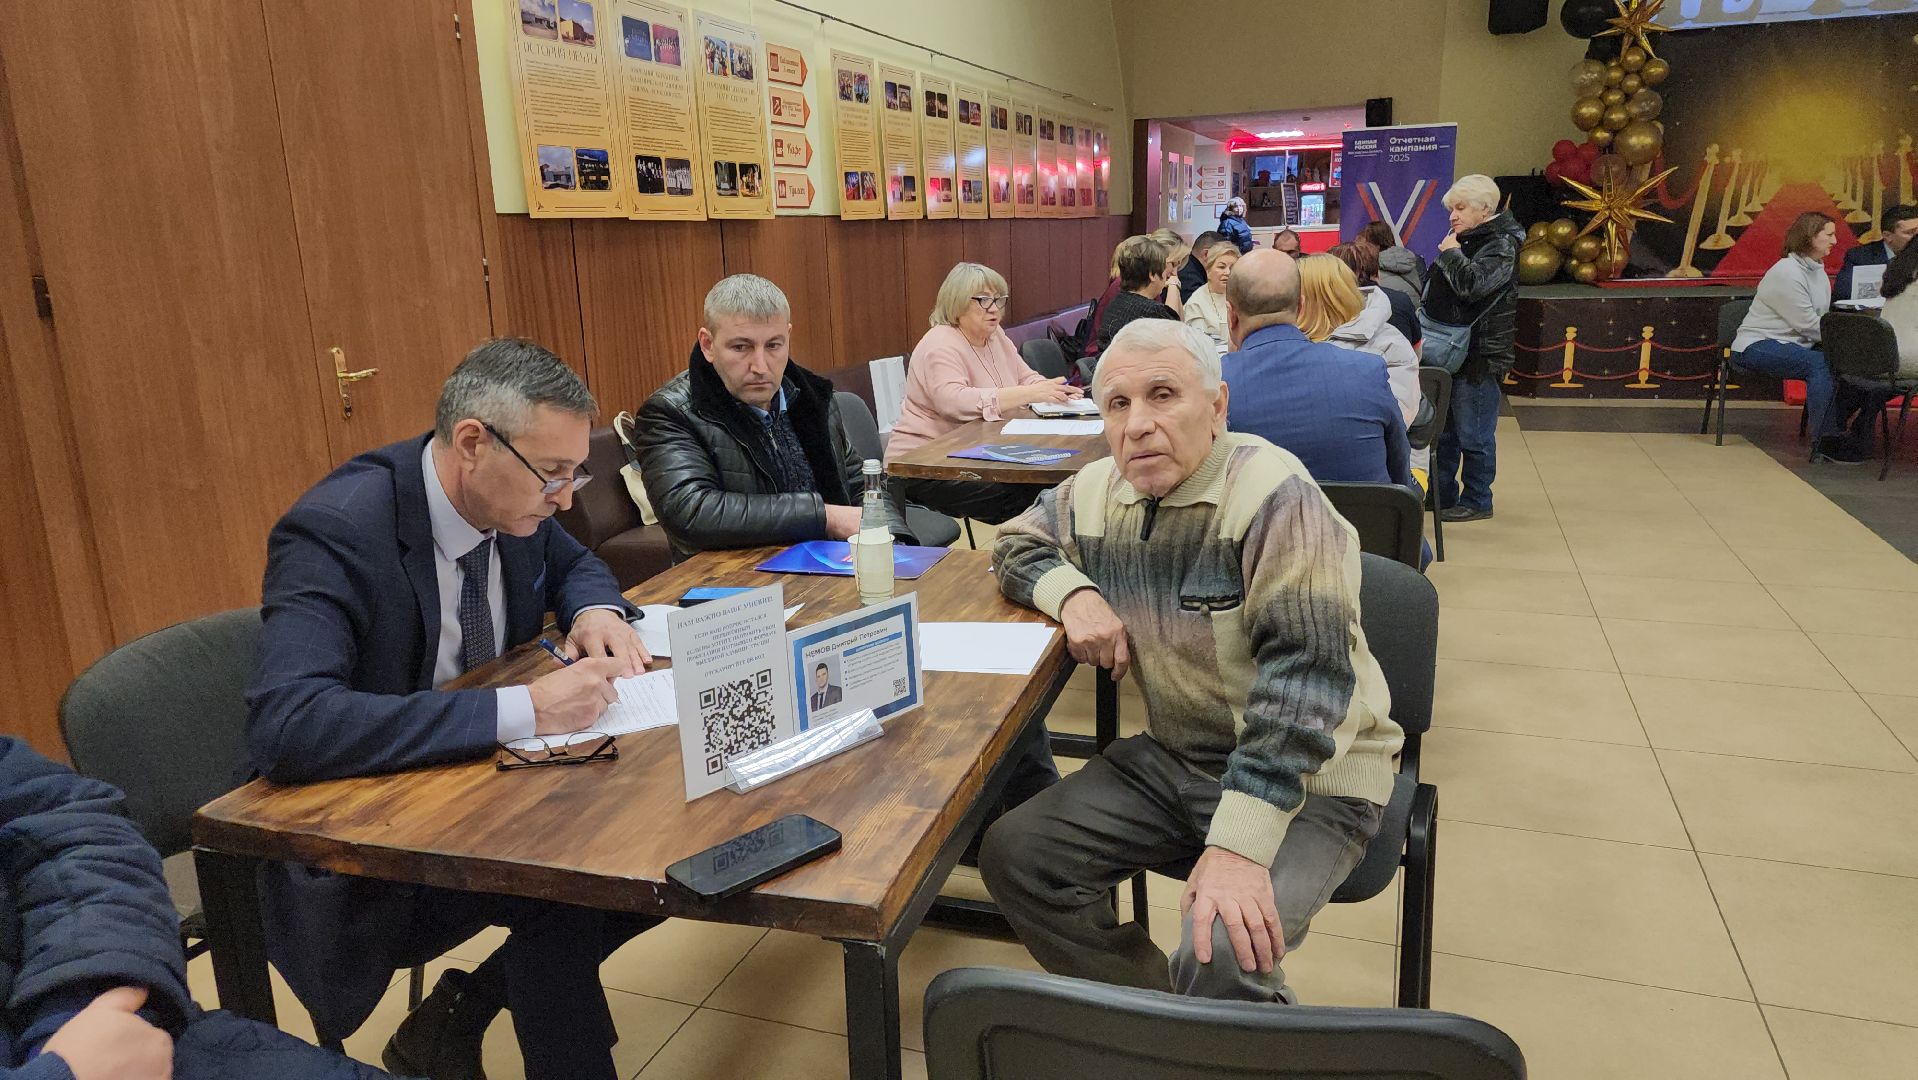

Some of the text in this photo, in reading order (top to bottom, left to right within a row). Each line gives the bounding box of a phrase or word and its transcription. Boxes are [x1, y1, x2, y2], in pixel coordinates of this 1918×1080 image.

[1389, 136, 1436, 144] Отчетная
[1389, 144, 1437, 153] кампания
[1389, 153, 1410, 162] 2025
[677, 619, 694, 630] НАМ
[695, 612, 721, 625] ВАЖНО
[722, 605, 741, 616] ВАШЕ
[859, 627, 888, 641] Петрович
